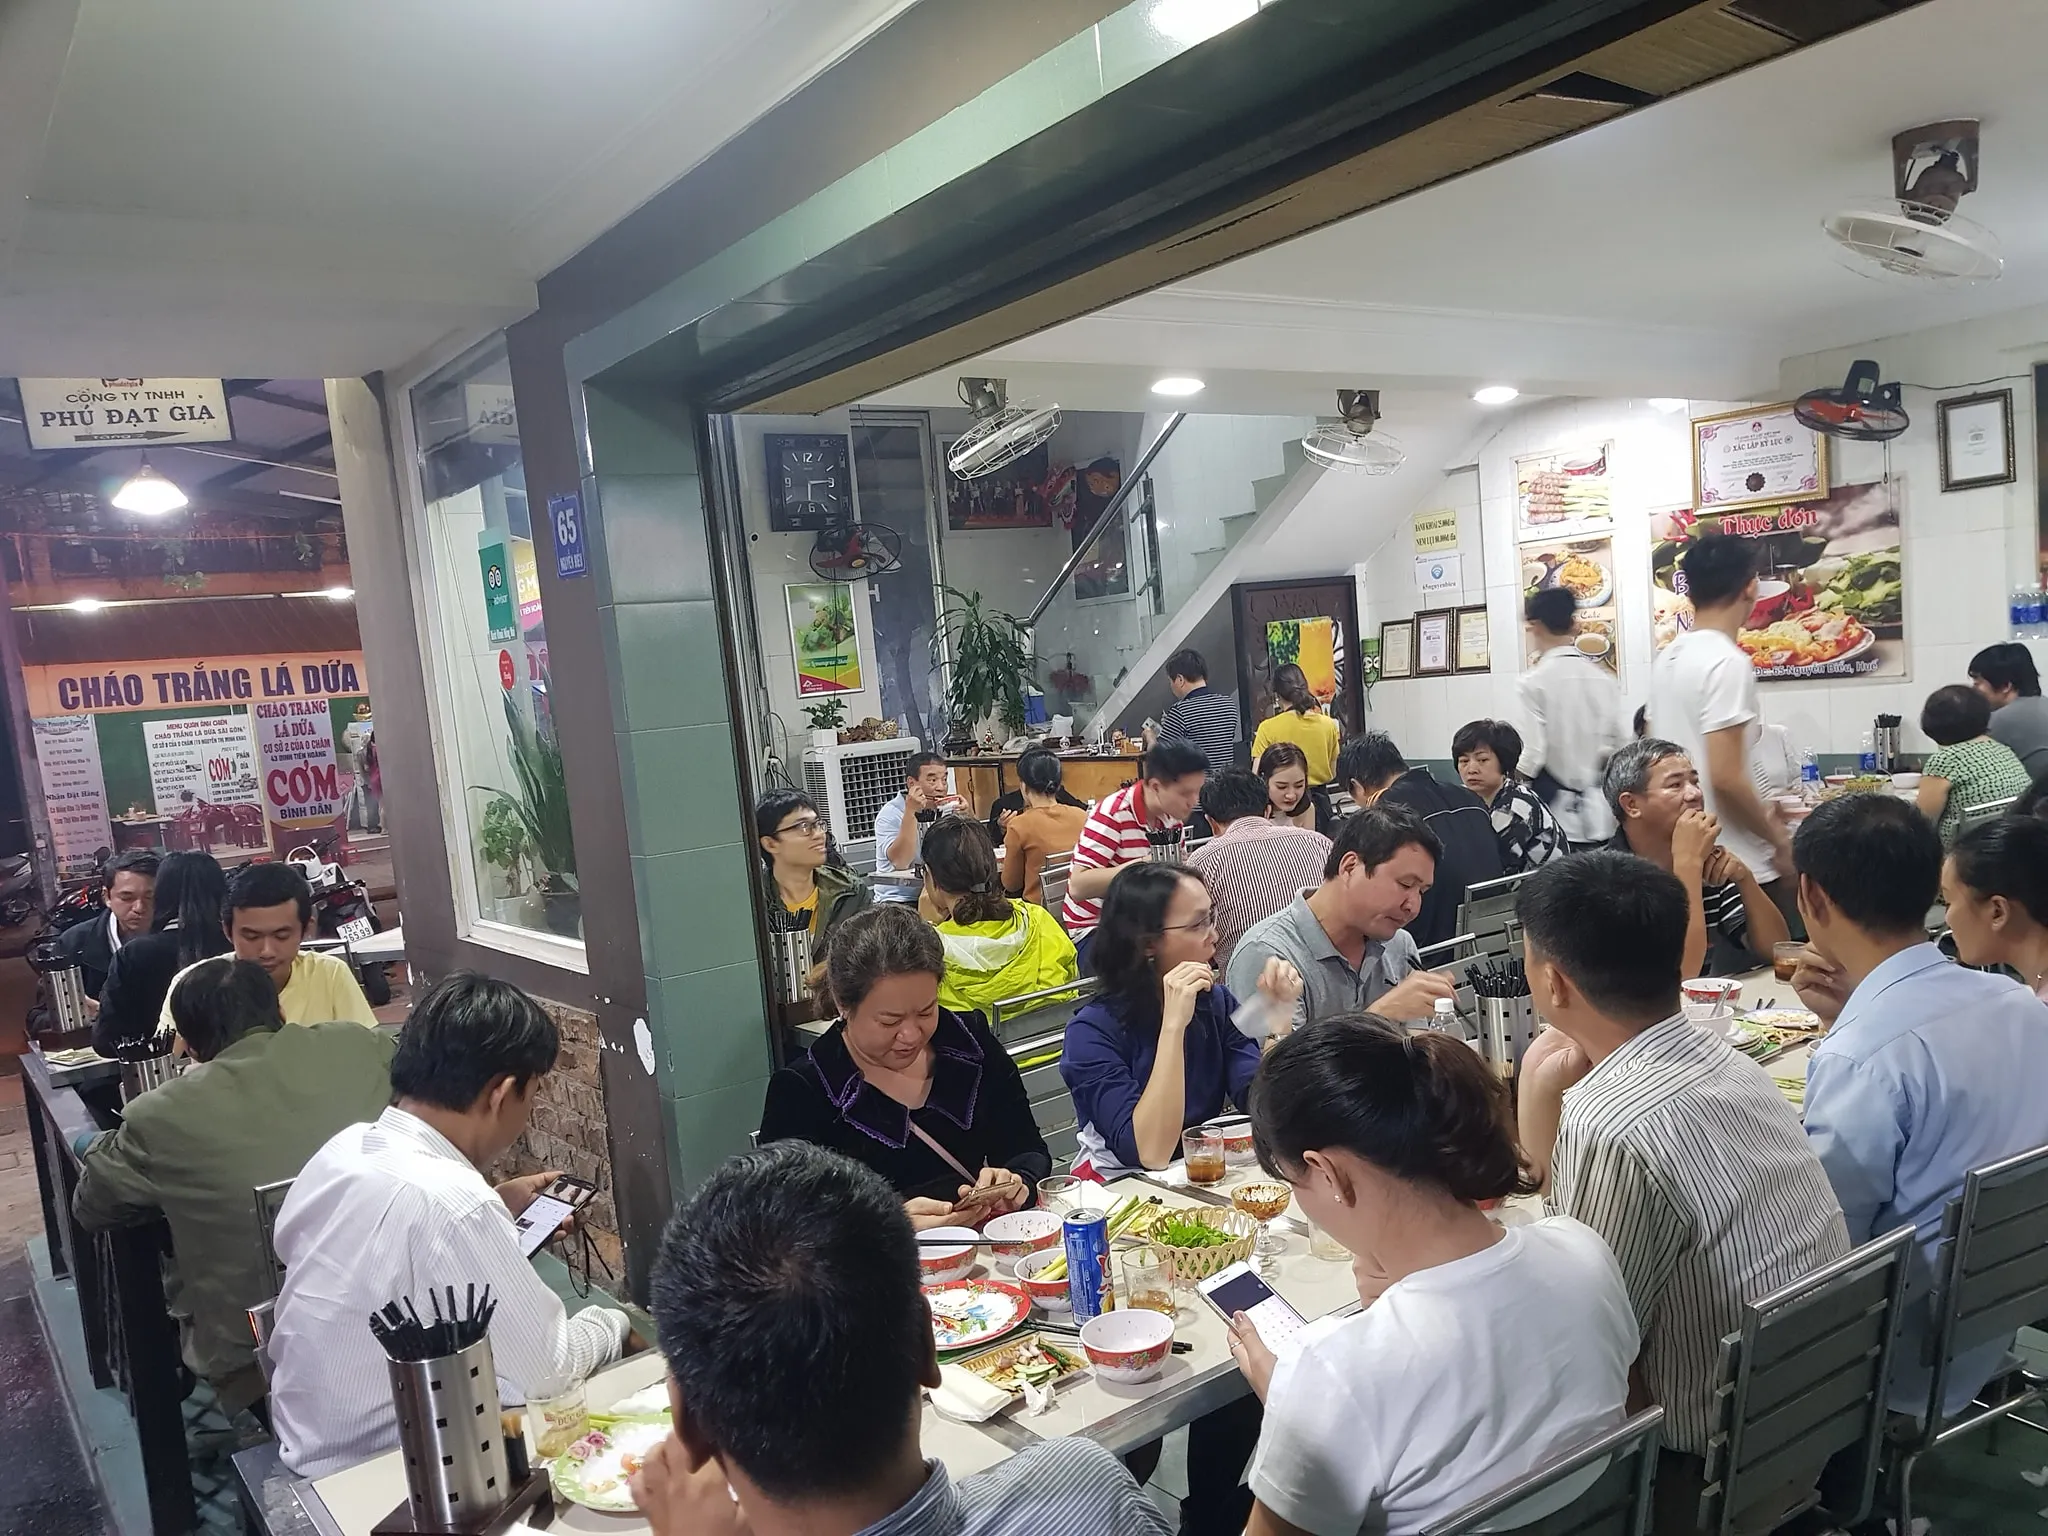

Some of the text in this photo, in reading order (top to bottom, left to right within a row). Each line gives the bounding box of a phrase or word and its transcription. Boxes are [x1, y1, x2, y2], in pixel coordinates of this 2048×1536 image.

[66, 388, 185, 403] CÔNG TY TNHH
[40, 404, 94, 427] PHÚ
[105, 407, 160, 428] ĐẠT
[803, 452, 813, 463] 12
[784, 477, 792, 488] 9
[828, 477, 834, 488] 3
[808, 502, 816, 512] 6
[557, 508, 577, 546] 65
[1719, 507, 1817, 538] Thực đơn
[57, 659, 360, 711] CHÁO TRẮNG LÁ DỨA
[274, 718, 316, 738] LÁ DỨA
[284, 743, 290, 752] 2
[267, 759, 340, 807] CƠM
[280, 802, 333, 820] BÌNH DÂN
